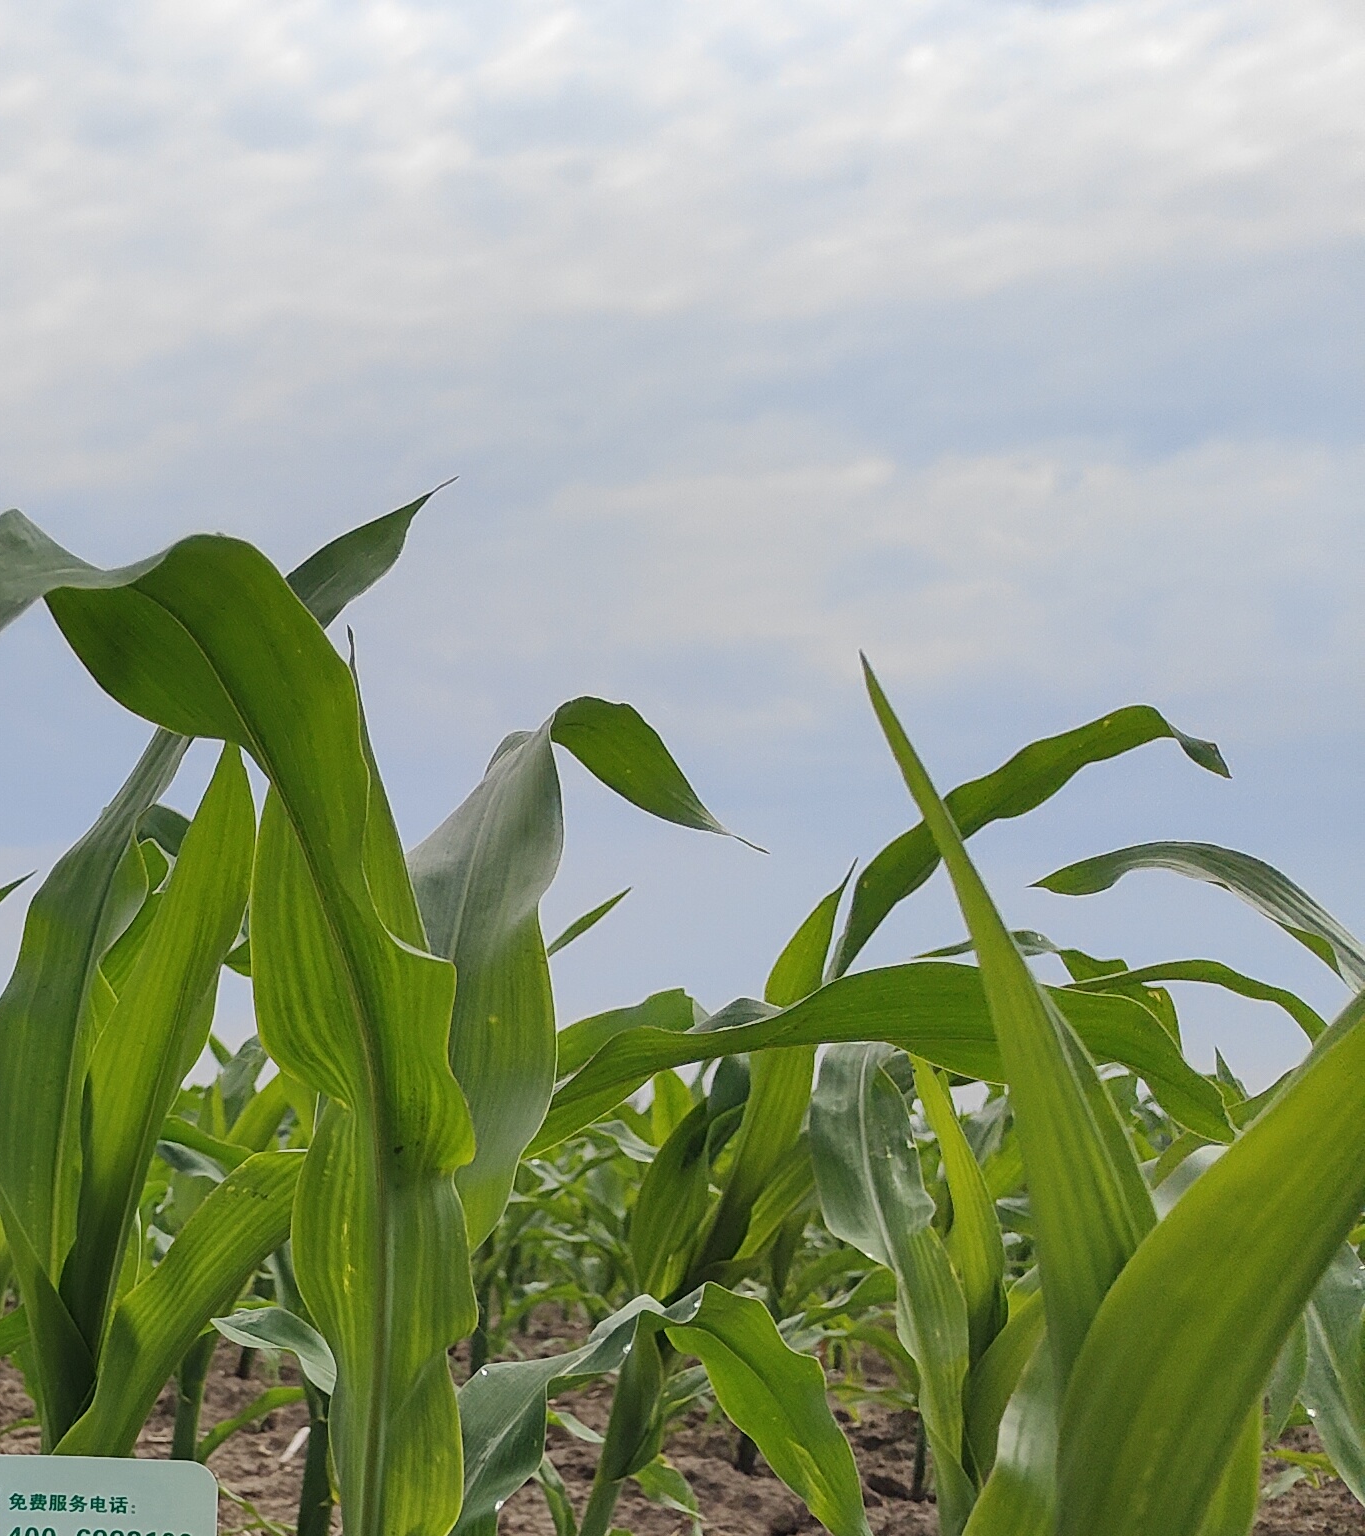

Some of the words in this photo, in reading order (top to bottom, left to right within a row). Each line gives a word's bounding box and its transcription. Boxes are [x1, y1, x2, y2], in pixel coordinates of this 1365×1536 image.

[8, 1493, 136, 1514] 免费服务电话：
